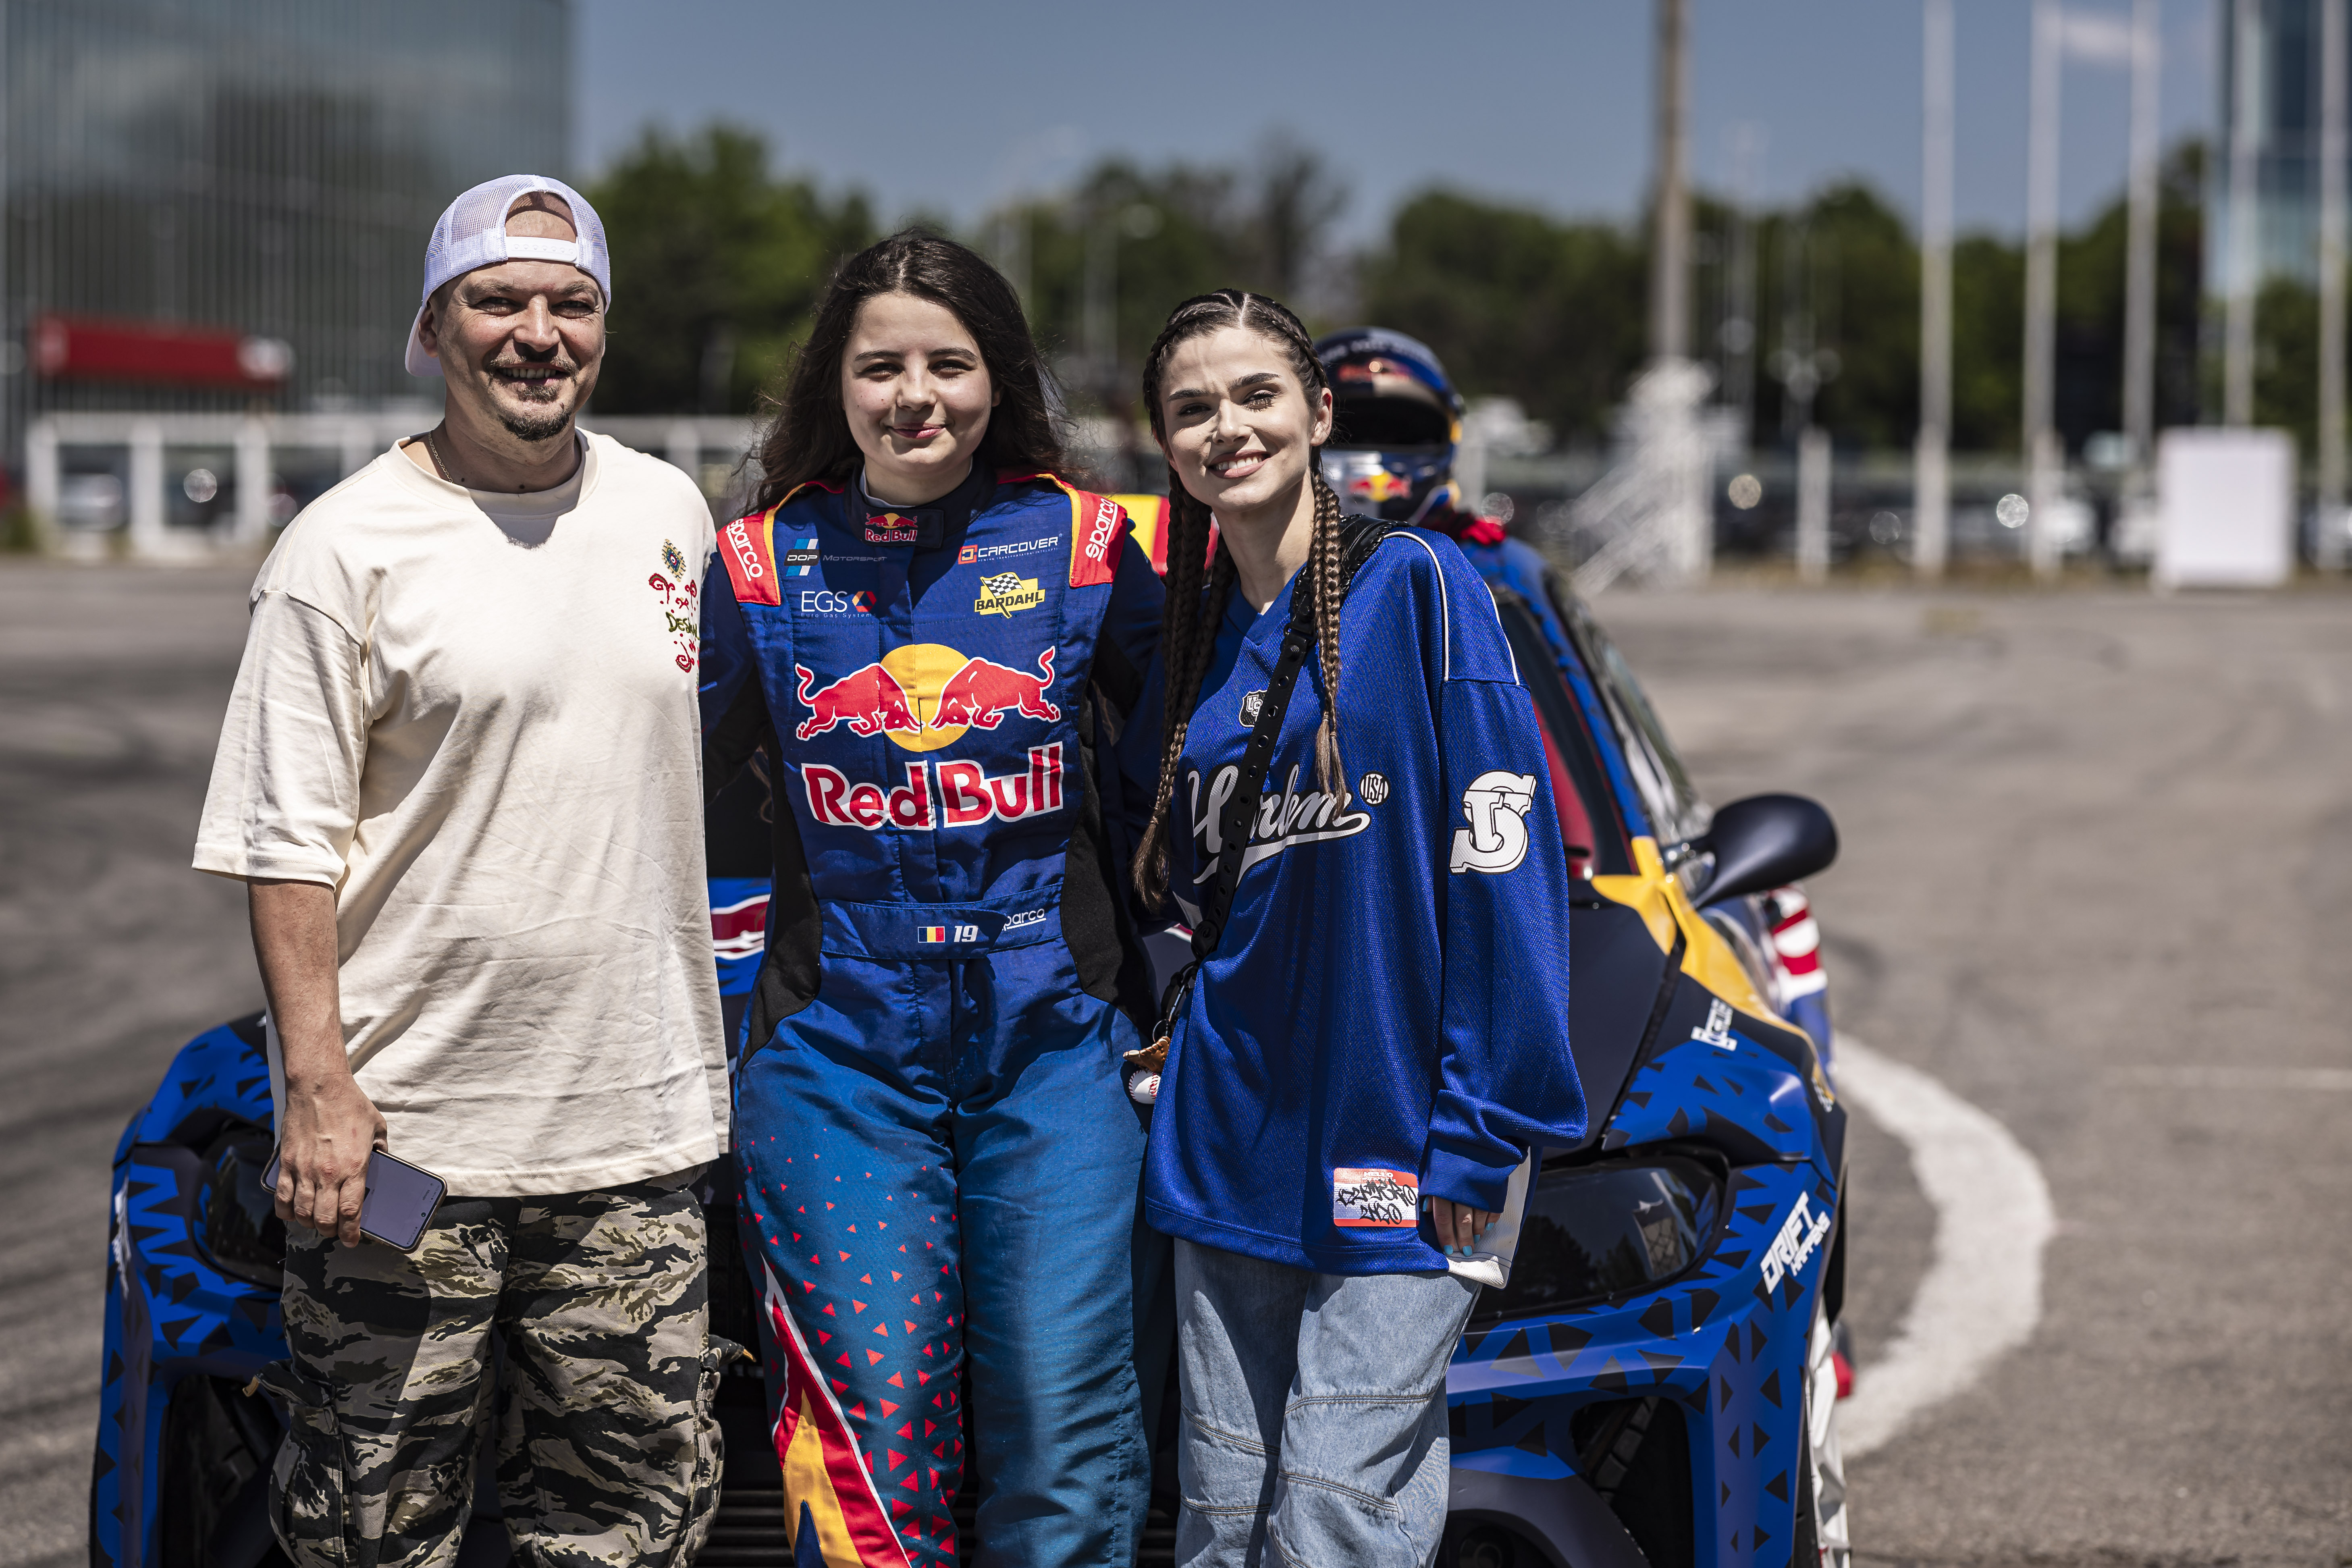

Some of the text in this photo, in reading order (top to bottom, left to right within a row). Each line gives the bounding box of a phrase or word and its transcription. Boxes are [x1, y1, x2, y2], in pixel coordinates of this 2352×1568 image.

[865, 528, 917, 542] Red Bull
[1085, 498, 1118, 562] sparco
[725, 518, 763, 582] sparco
[978, 536, 1058, 558] CARCOVER
[801, 591, 848, 613] EGS
[977, 592, 1043, 611] BARDAHL
[801, 741, 1064, 831] Red Bull
[1001, 908, 1046, 931] parco
[954, 925, 979, 943] 19
[1760, 1190, 1814, 1294] DRIFT
